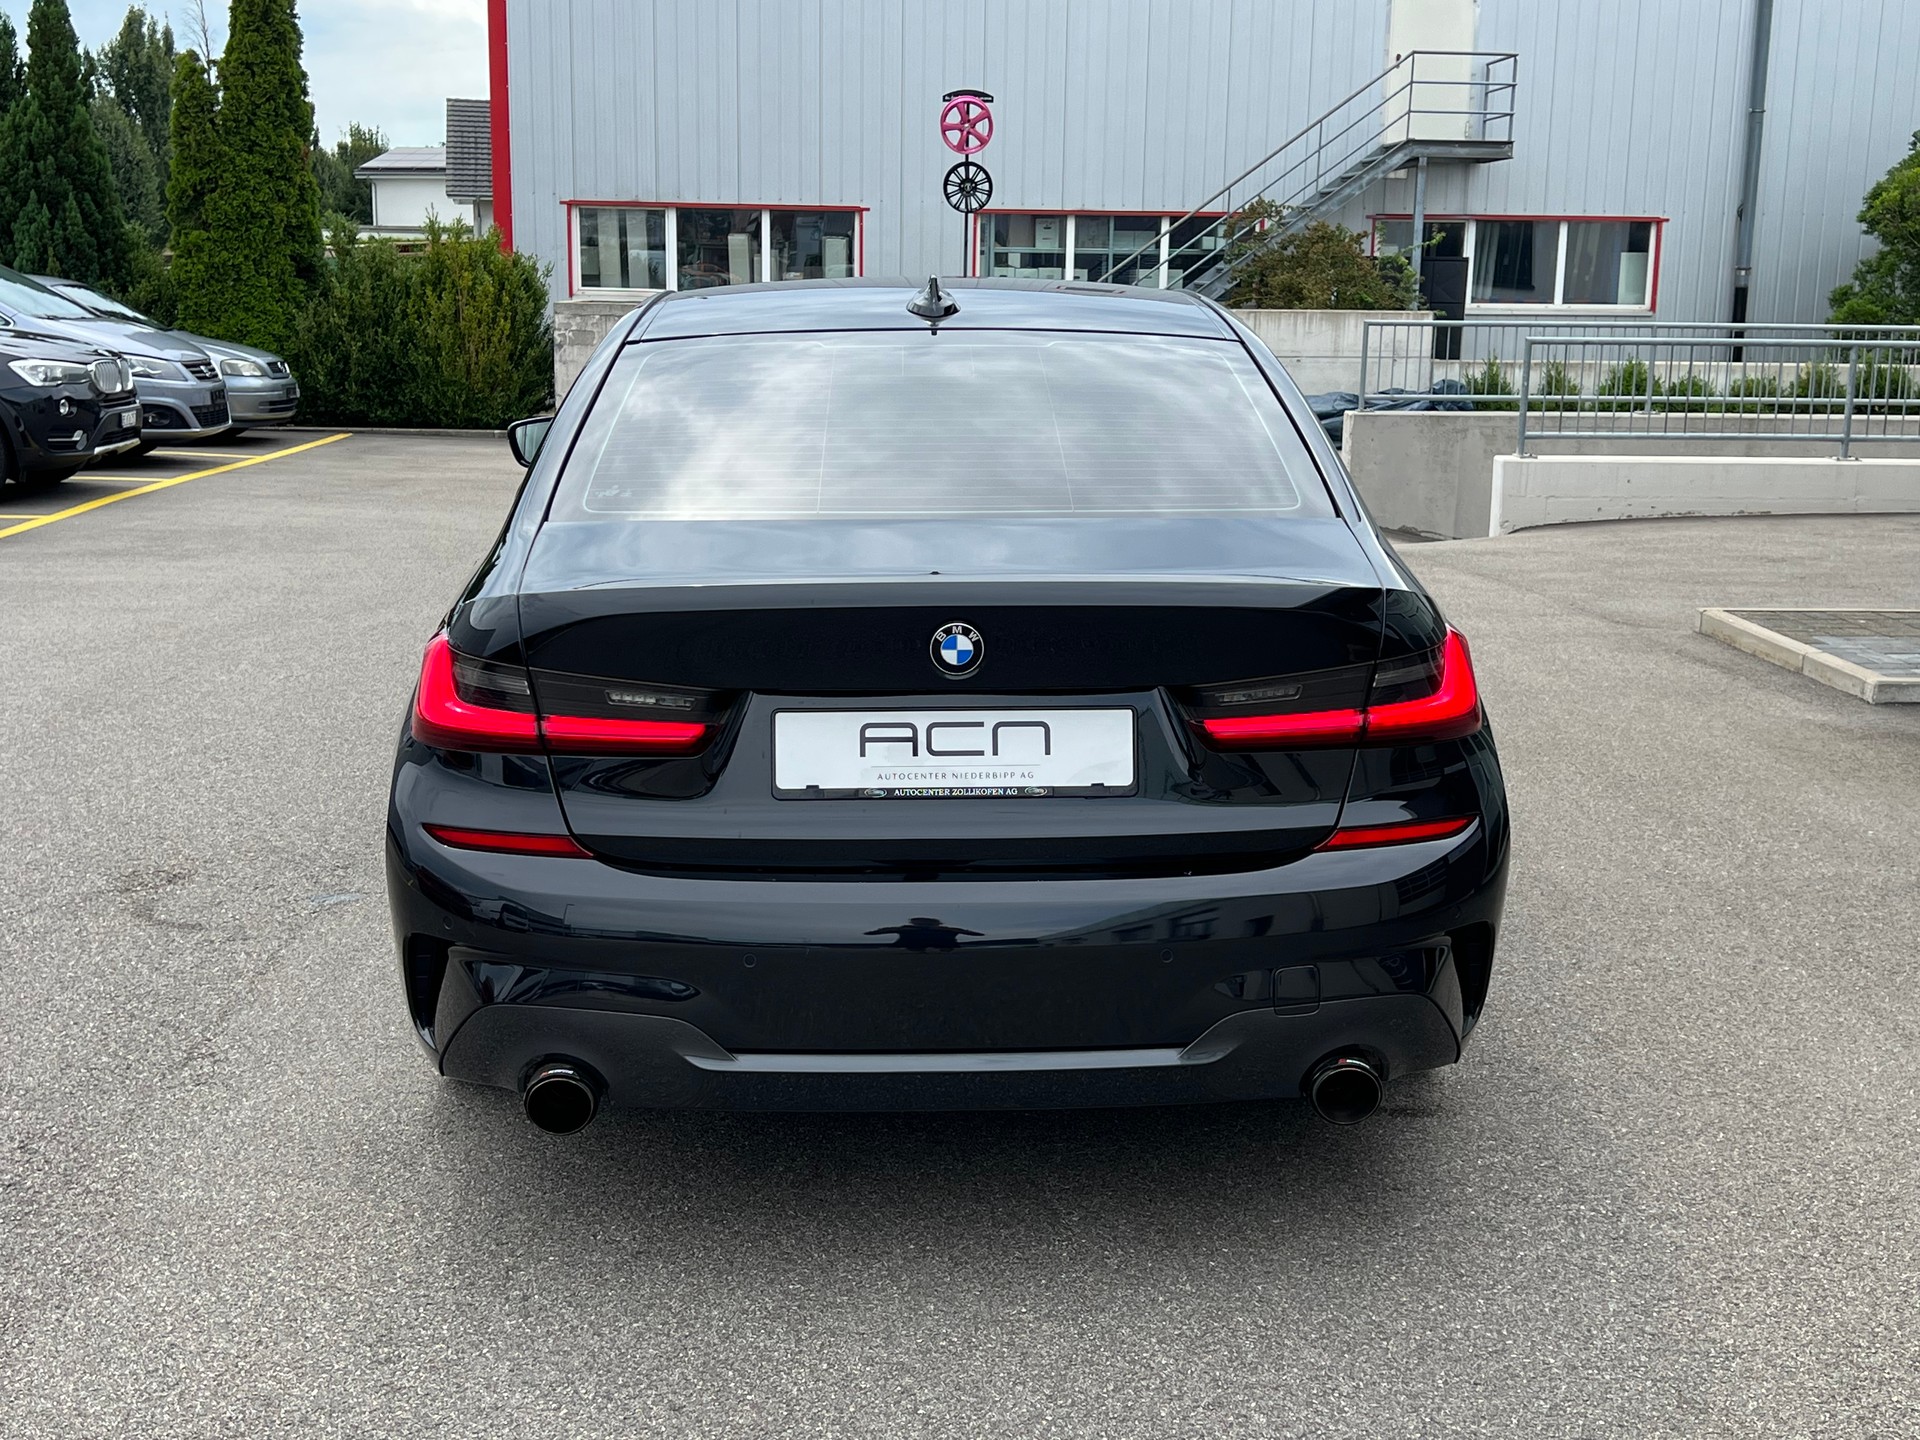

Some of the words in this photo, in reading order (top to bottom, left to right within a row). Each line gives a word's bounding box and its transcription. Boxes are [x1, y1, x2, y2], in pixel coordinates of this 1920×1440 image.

[936, 626, 979, 642] BMW
[859, 721, 1051, 757] ACN
[877, 772, 947, 781] AUTOCENTER
[952, 772, 1016, 780] NIEDERBIPP
[1020, 771, 1035, 780] AG
[894, 788, 950, 797] AUTOCENTER
[952, 787, 1004, 796] ZOLLIKOFEN
[1006, 787, 1018, 796] AG
